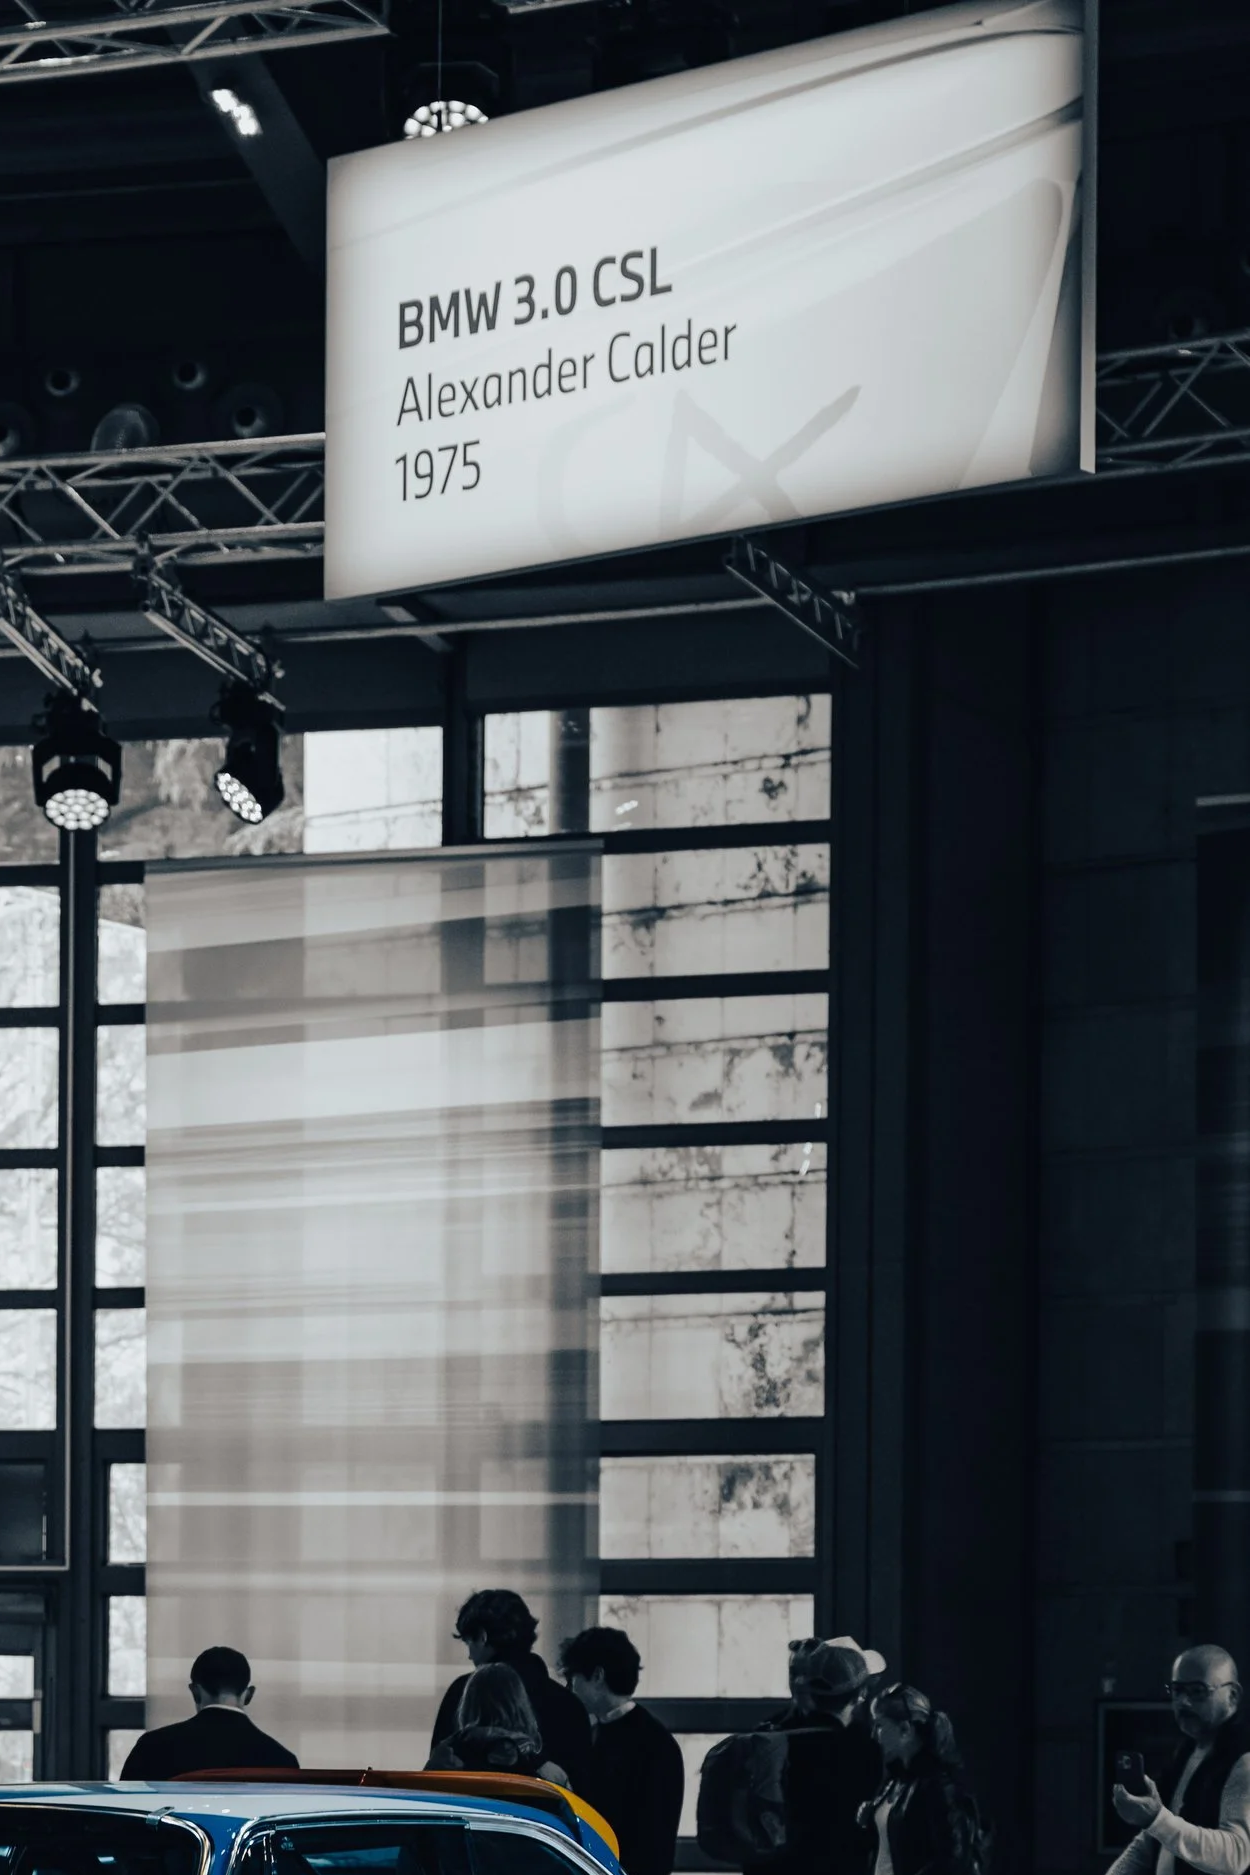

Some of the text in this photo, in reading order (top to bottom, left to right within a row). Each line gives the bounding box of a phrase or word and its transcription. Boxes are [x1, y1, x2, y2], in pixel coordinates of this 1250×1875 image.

[399, 246, 672, 349] BMW 3.0 CSL
[397, 318, 737, 427] Alexander Calder
[395, 440, 481, 502] 1975
